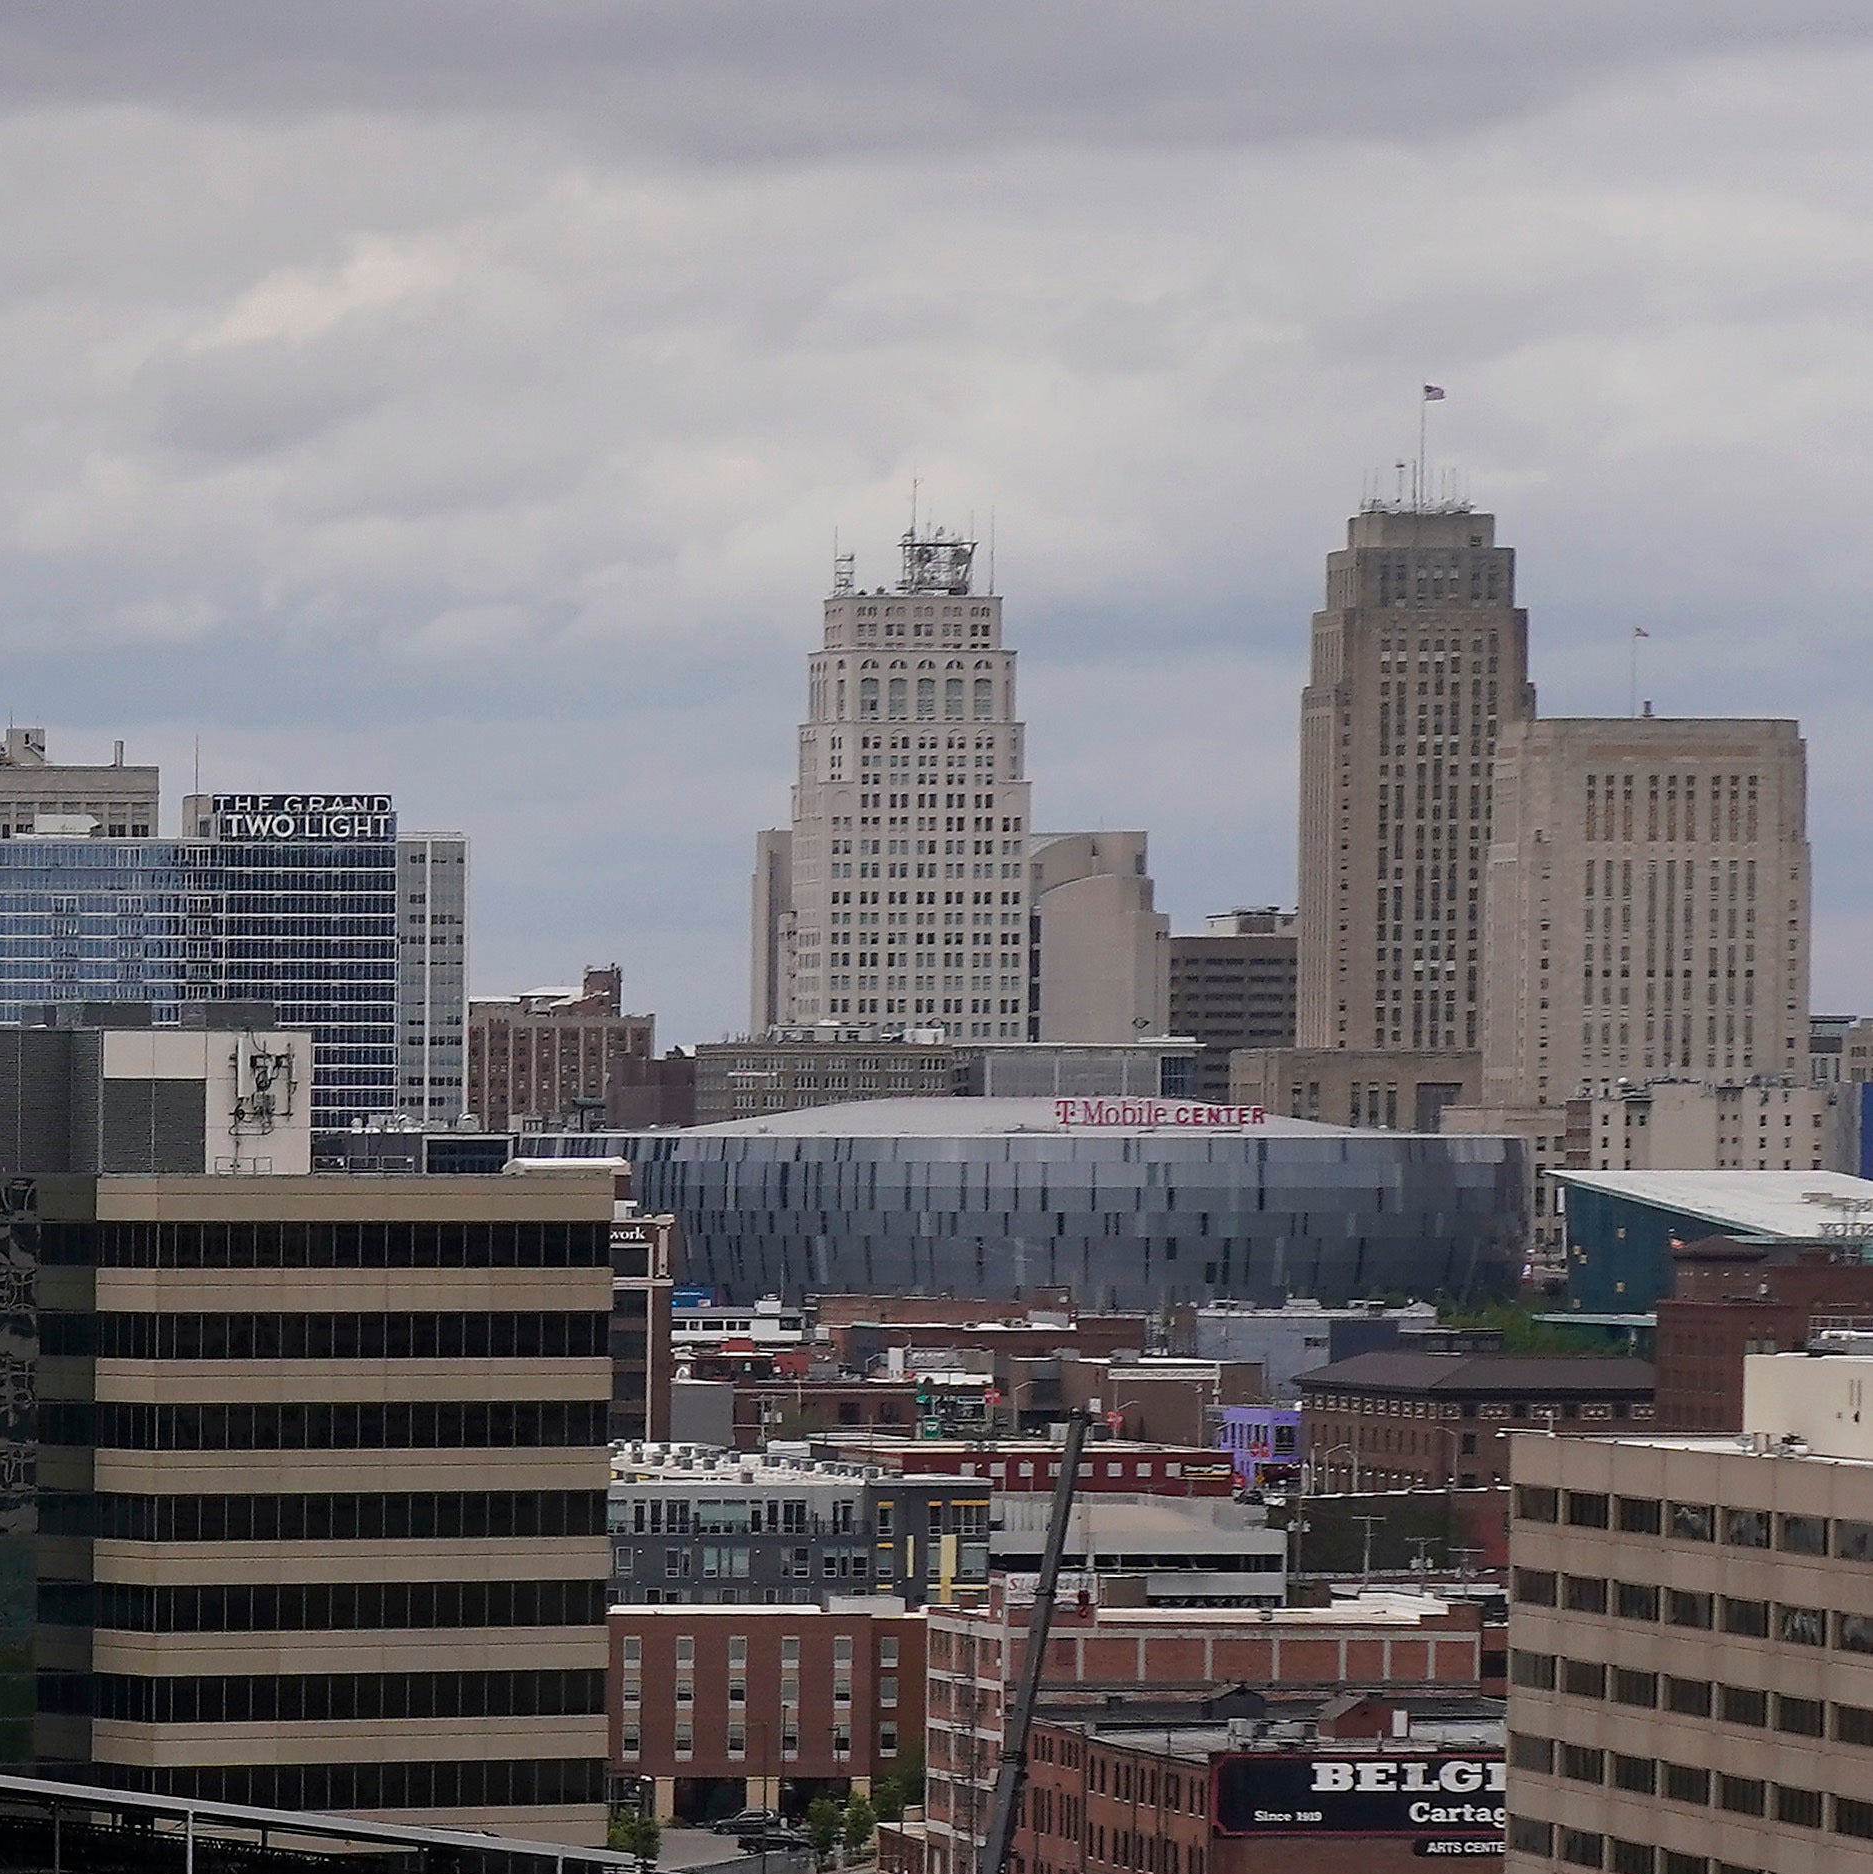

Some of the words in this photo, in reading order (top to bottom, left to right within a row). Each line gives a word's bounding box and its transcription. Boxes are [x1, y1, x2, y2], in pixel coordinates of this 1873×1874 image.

[213, 796, 274, 812] THE
[284, 795, 391, 813] GRAND
[225, 814, 295, 838] TWO
[305, 814, 390, 838] LIGHT
[1176, 1106, 1266, 1124] CENTER
[1254, 1810, 1292, 1822] Since
[1295, 1811, 1323, 1822] 1919
[1426, 1841, 1462, 1854] ARTS
[1463, 1841, 1506, 1854] CENTE
